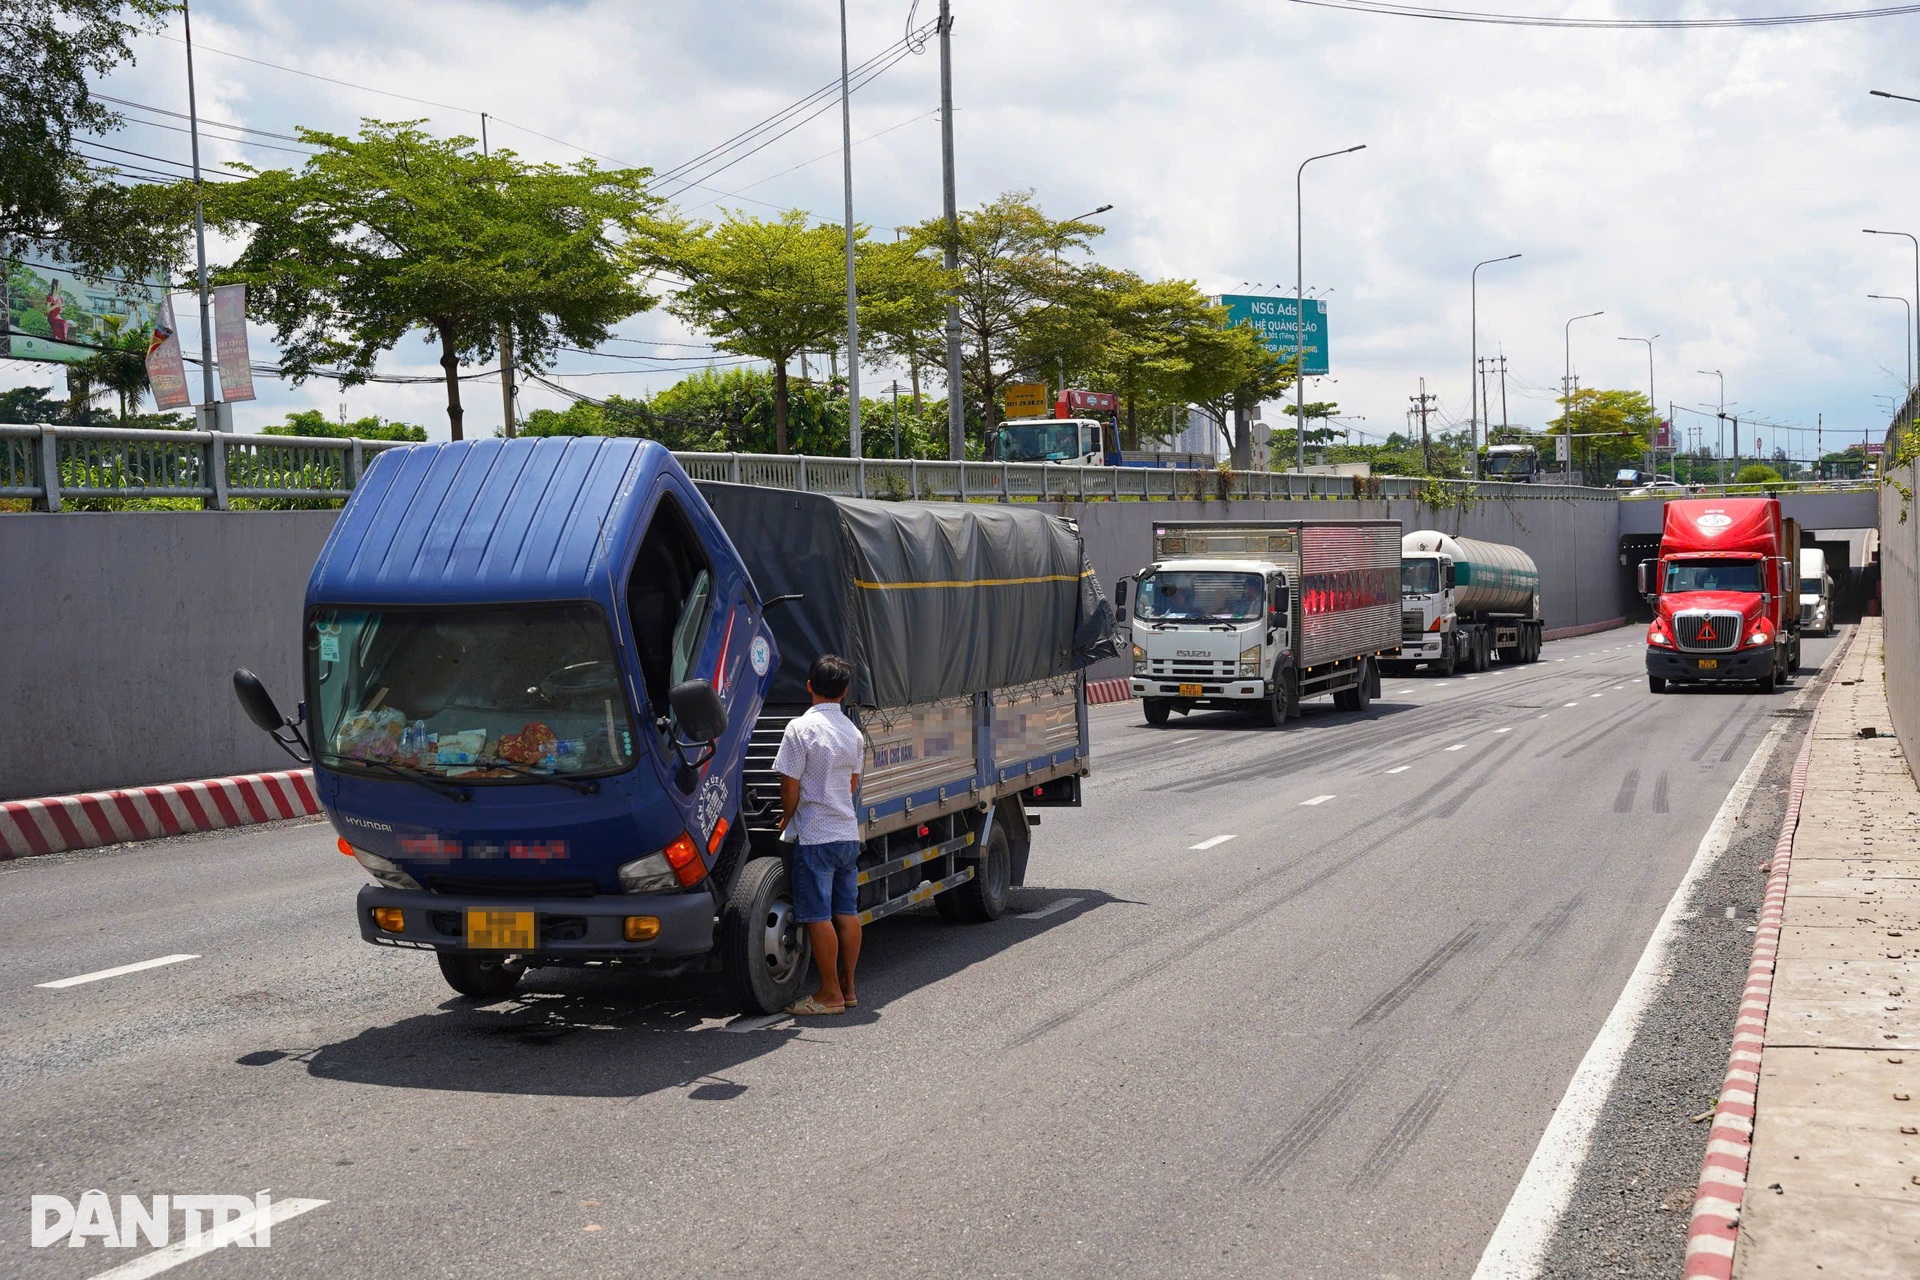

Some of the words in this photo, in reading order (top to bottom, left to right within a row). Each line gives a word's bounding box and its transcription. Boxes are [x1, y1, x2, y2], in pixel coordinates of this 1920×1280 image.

[1251, 302, 1275, 315] NSG
[1277, 303, 1298, 316] Ads
[1301, 320, 1317, 332] CÁO
[1265, 344, 1278, 352] FOR
[1176, 650, 1211, 658] ISUZU
[345, 815, 393, 832] HYUNDAI
